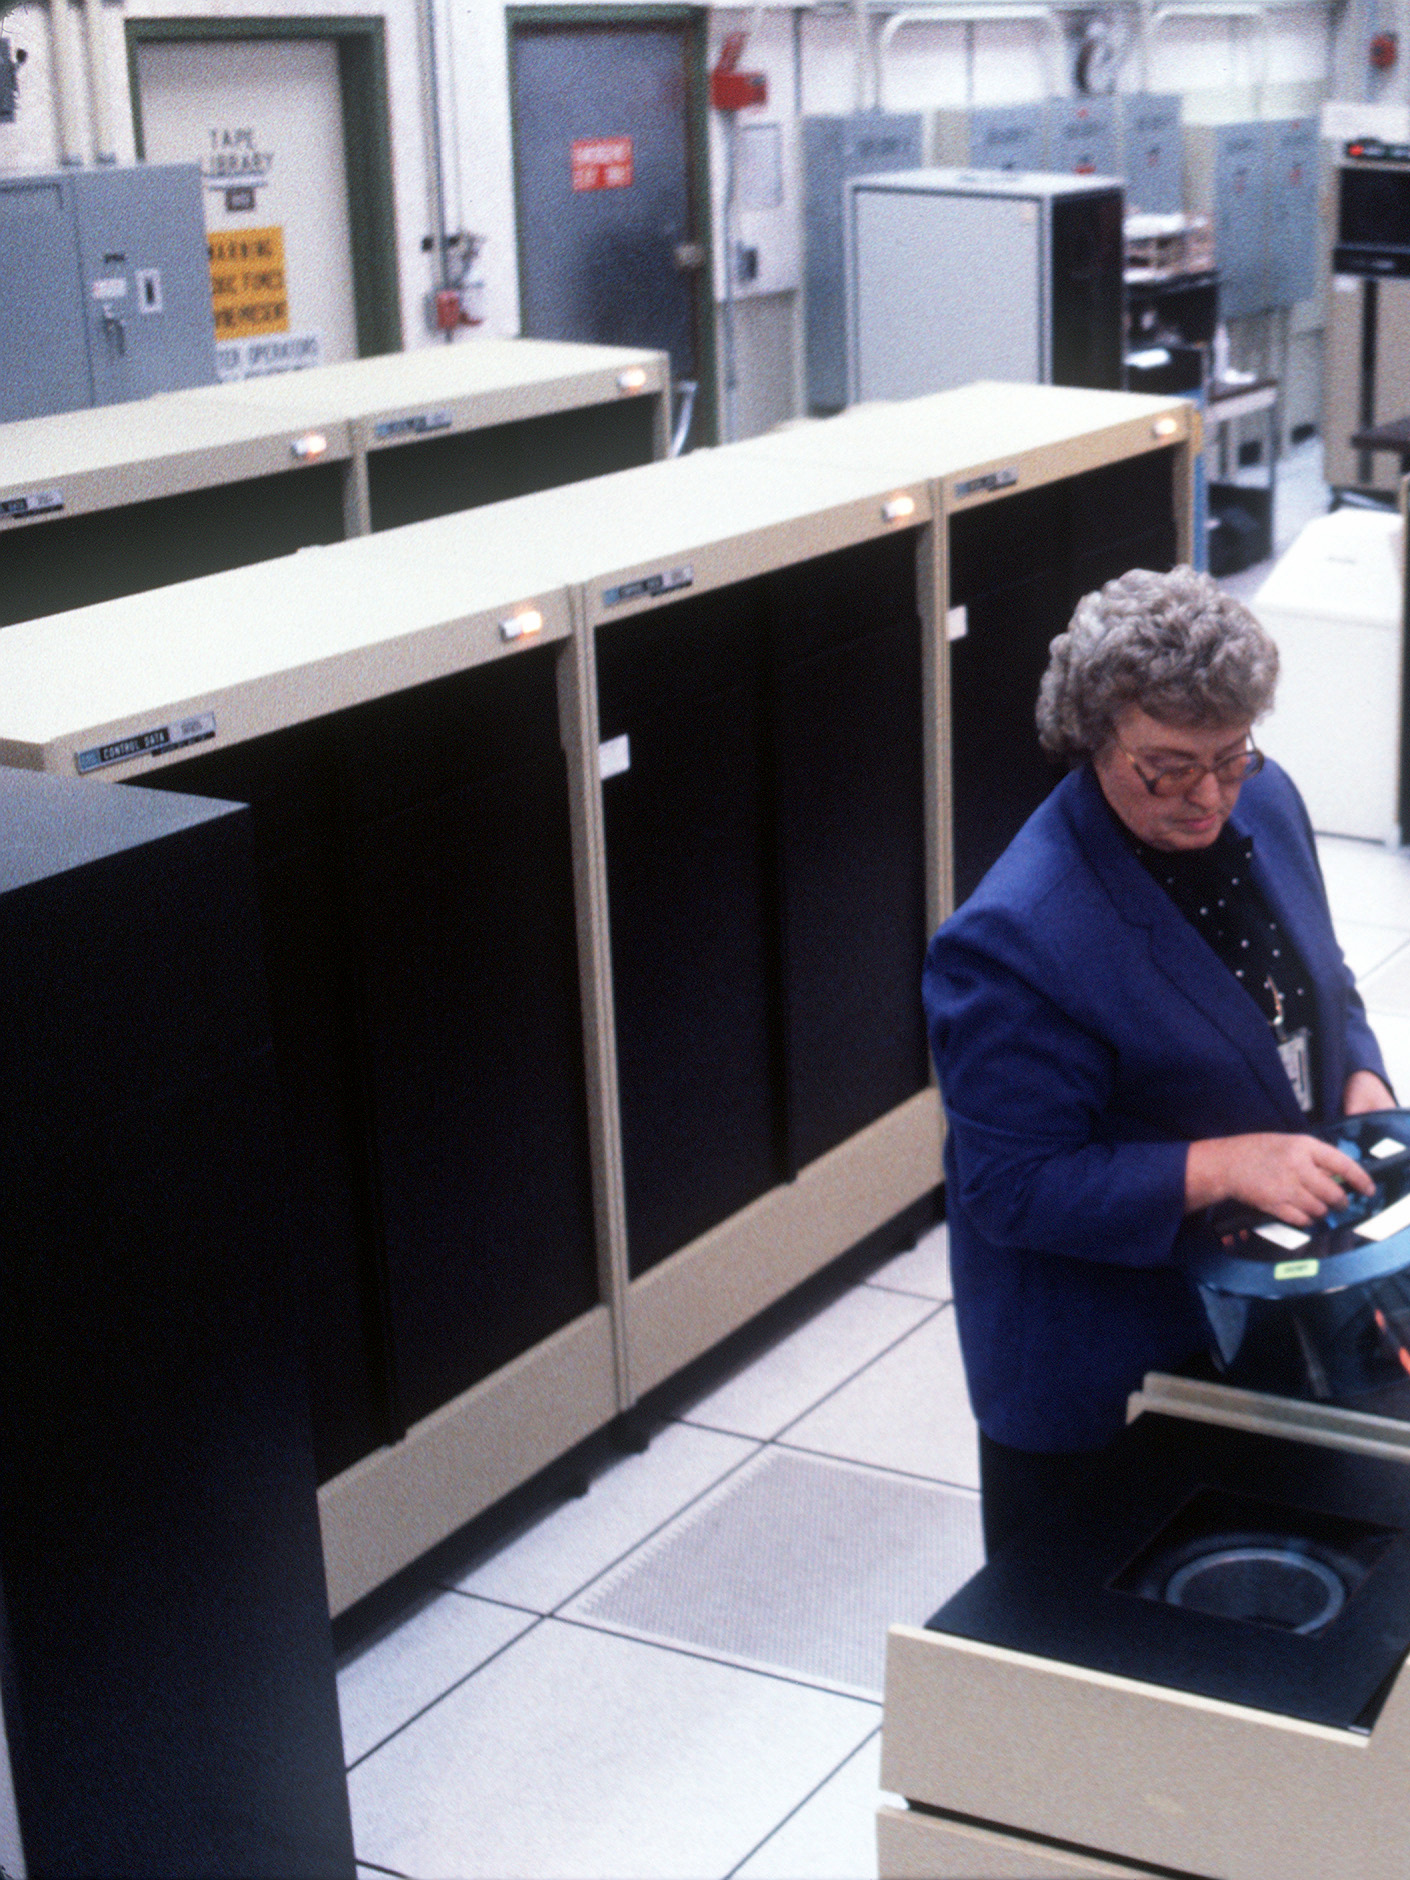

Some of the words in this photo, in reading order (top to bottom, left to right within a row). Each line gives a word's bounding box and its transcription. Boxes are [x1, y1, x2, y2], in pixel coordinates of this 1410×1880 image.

[208, 127, 254, 149] TAPE
[103, 740, 140, 760] CONTROL
[144, 732, 165, 747] DATA
